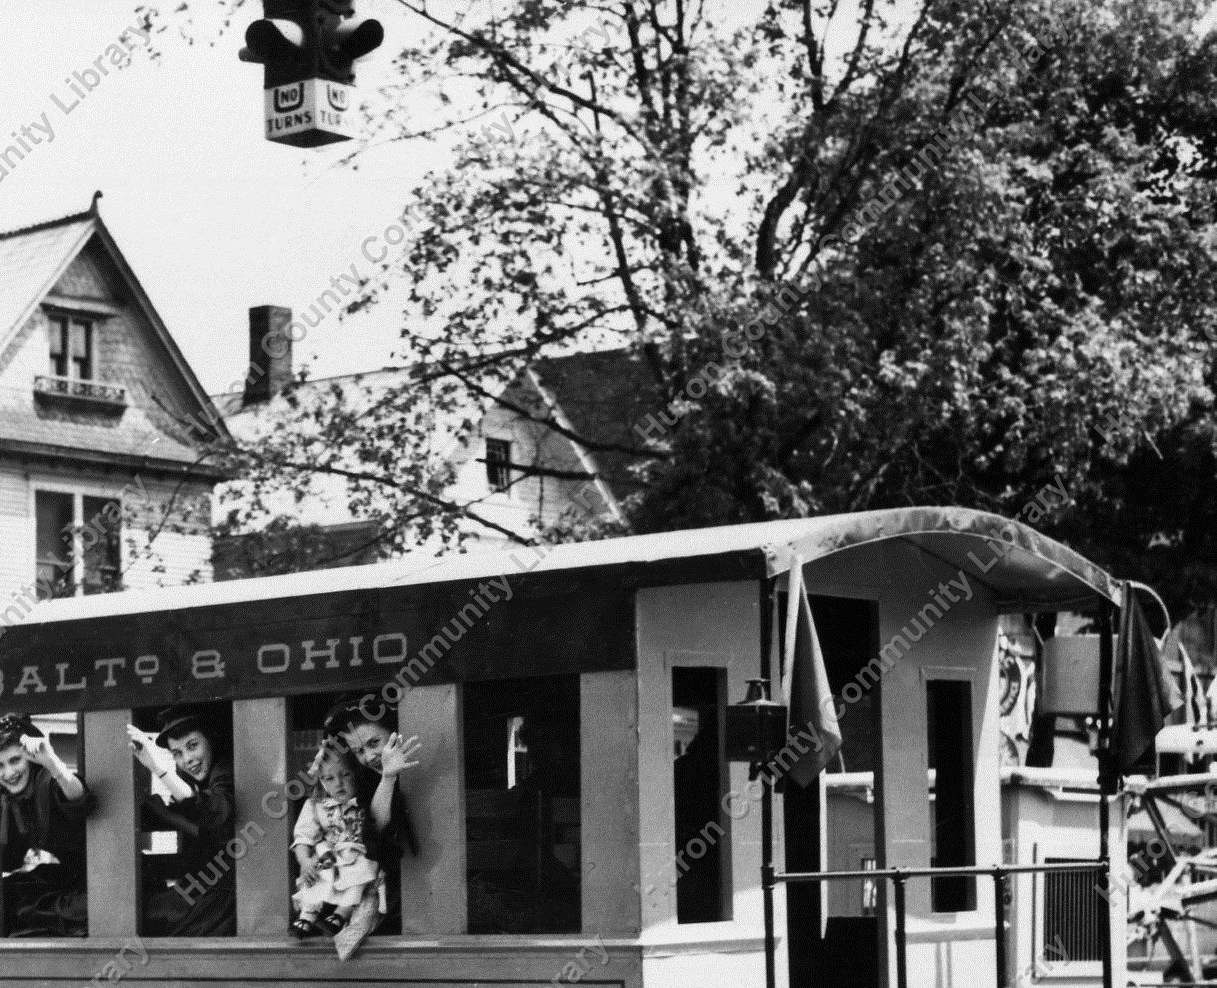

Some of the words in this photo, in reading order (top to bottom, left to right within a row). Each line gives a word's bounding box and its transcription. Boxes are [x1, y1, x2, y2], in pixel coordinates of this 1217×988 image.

[281, 88, 298, 103] NO
[267, 111, 312, 133] TURNS
[192, 649, 225, 679] &
[257, 633, 408, 672] OHIO
